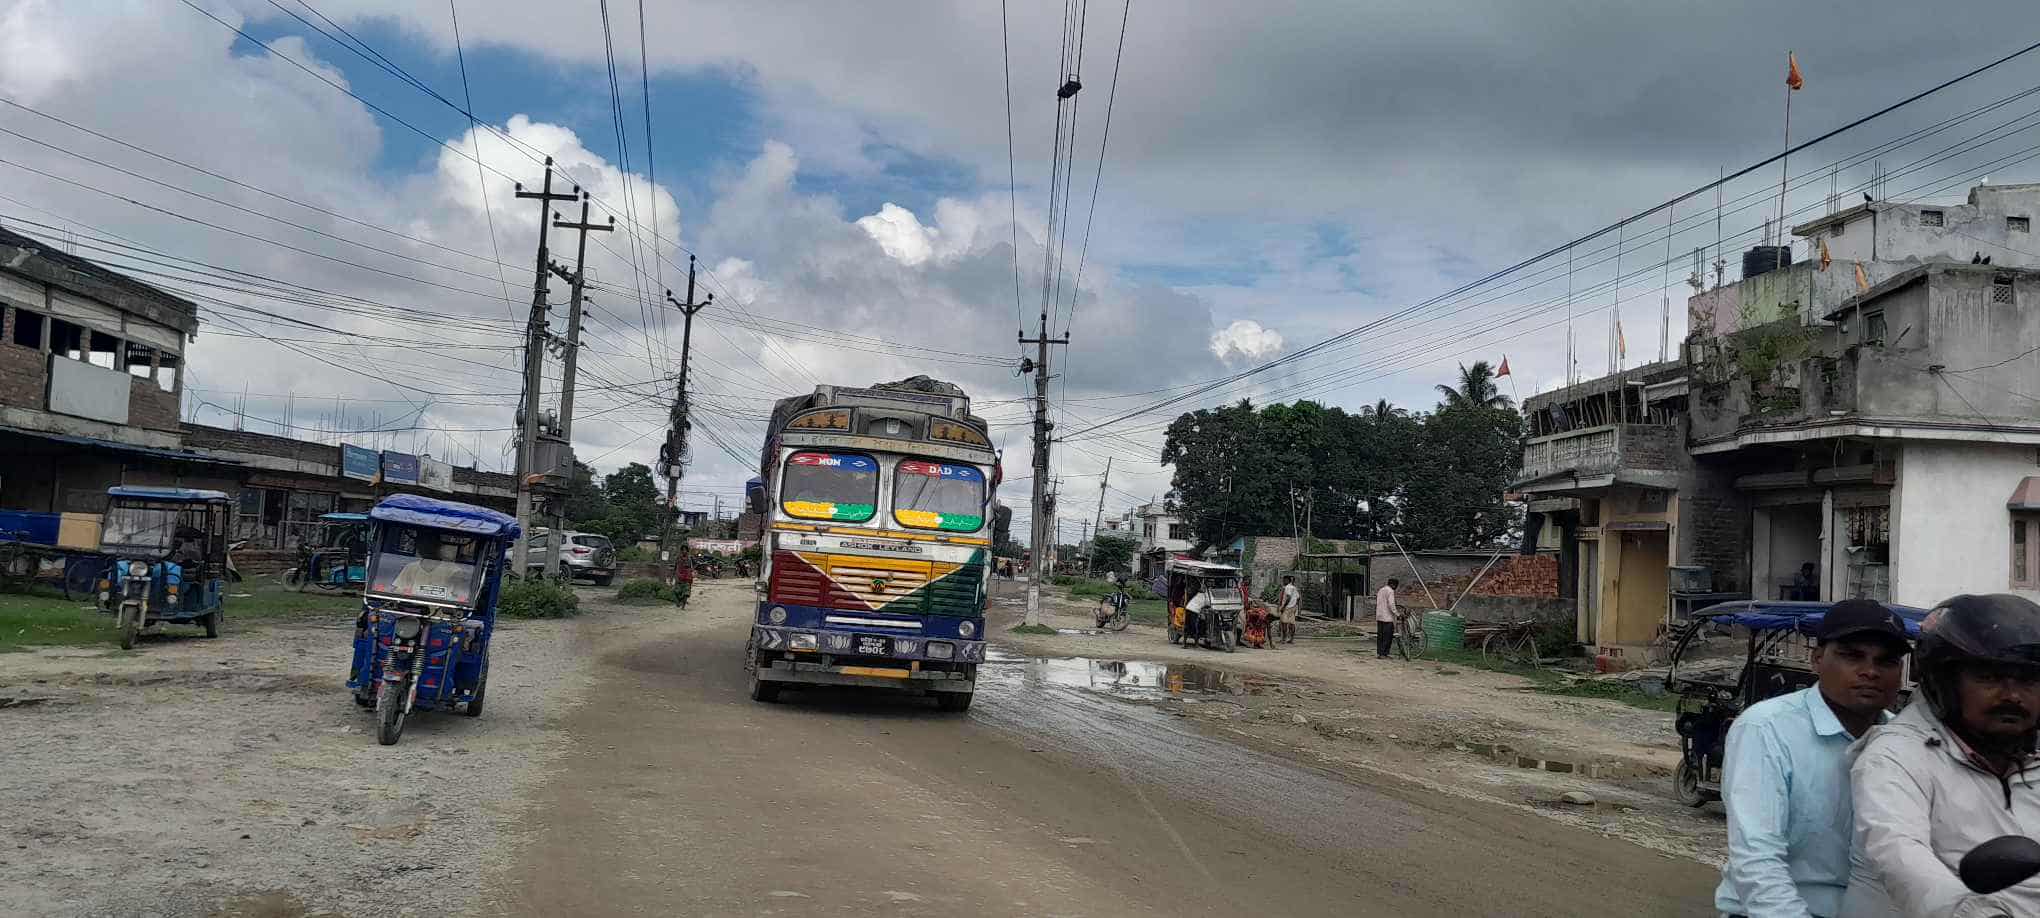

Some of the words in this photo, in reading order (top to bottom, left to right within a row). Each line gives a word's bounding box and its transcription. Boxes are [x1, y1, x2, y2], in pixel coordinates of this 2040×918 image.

[929, 465, 953, 475] DAD
[840, 541, 873, 550] ASHOK
[880, 544, 922, 553] LEYLAND
